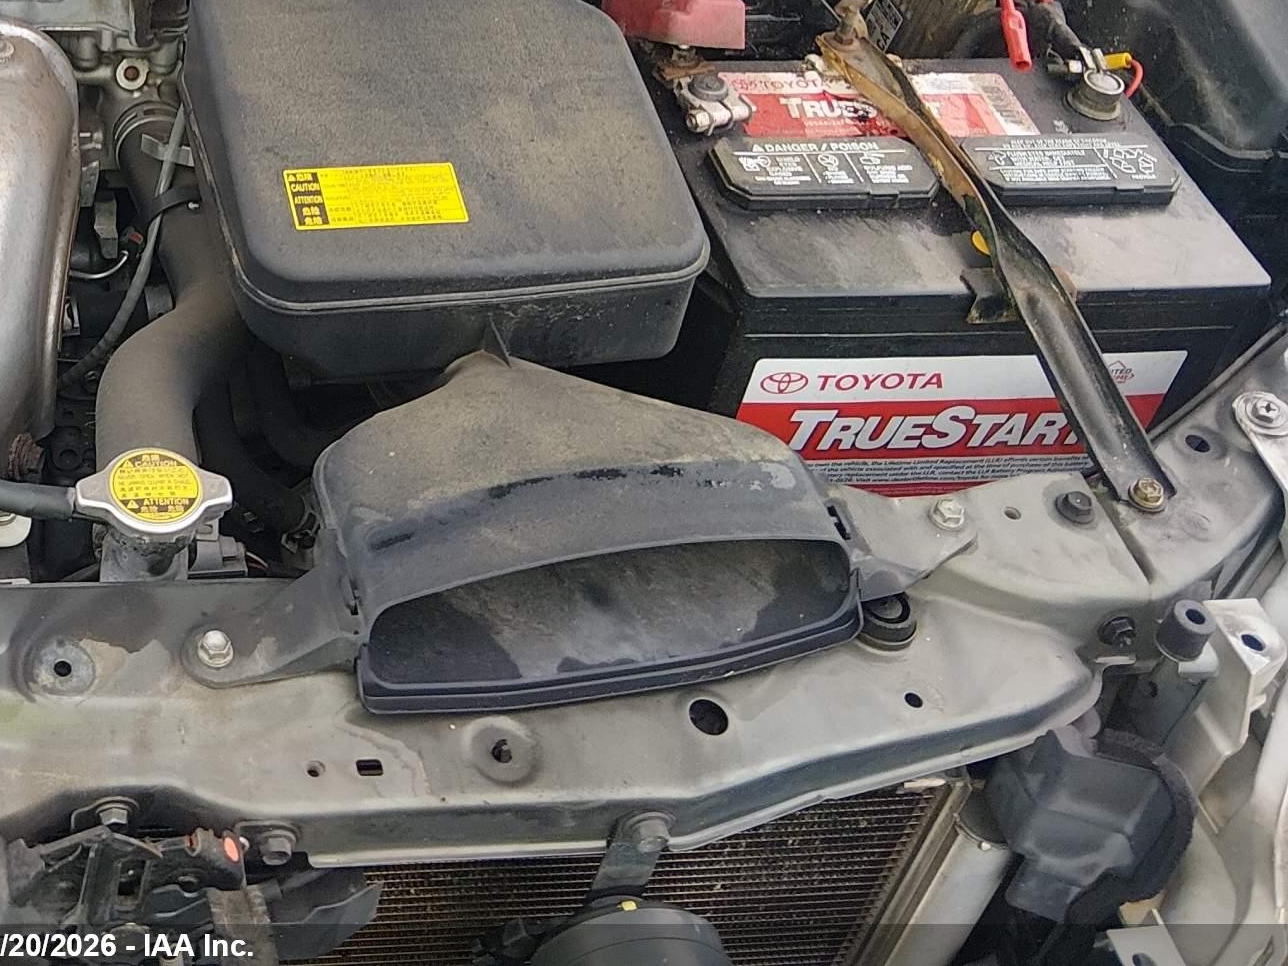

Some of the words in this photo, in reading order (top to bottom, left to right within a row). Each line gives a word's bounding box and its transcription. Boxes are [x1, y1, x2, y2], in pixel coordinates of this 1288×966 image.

[765, 143, 818, 152] DANGER
[830, 142, 879, 150] POISON
[291, 182, 320, 192] CAUTION
[294, 195, 324, 204] ATTENTION
[817, 372, 944, 391] TOYOTA
[143, 498, 189, 506] ATTENTION
